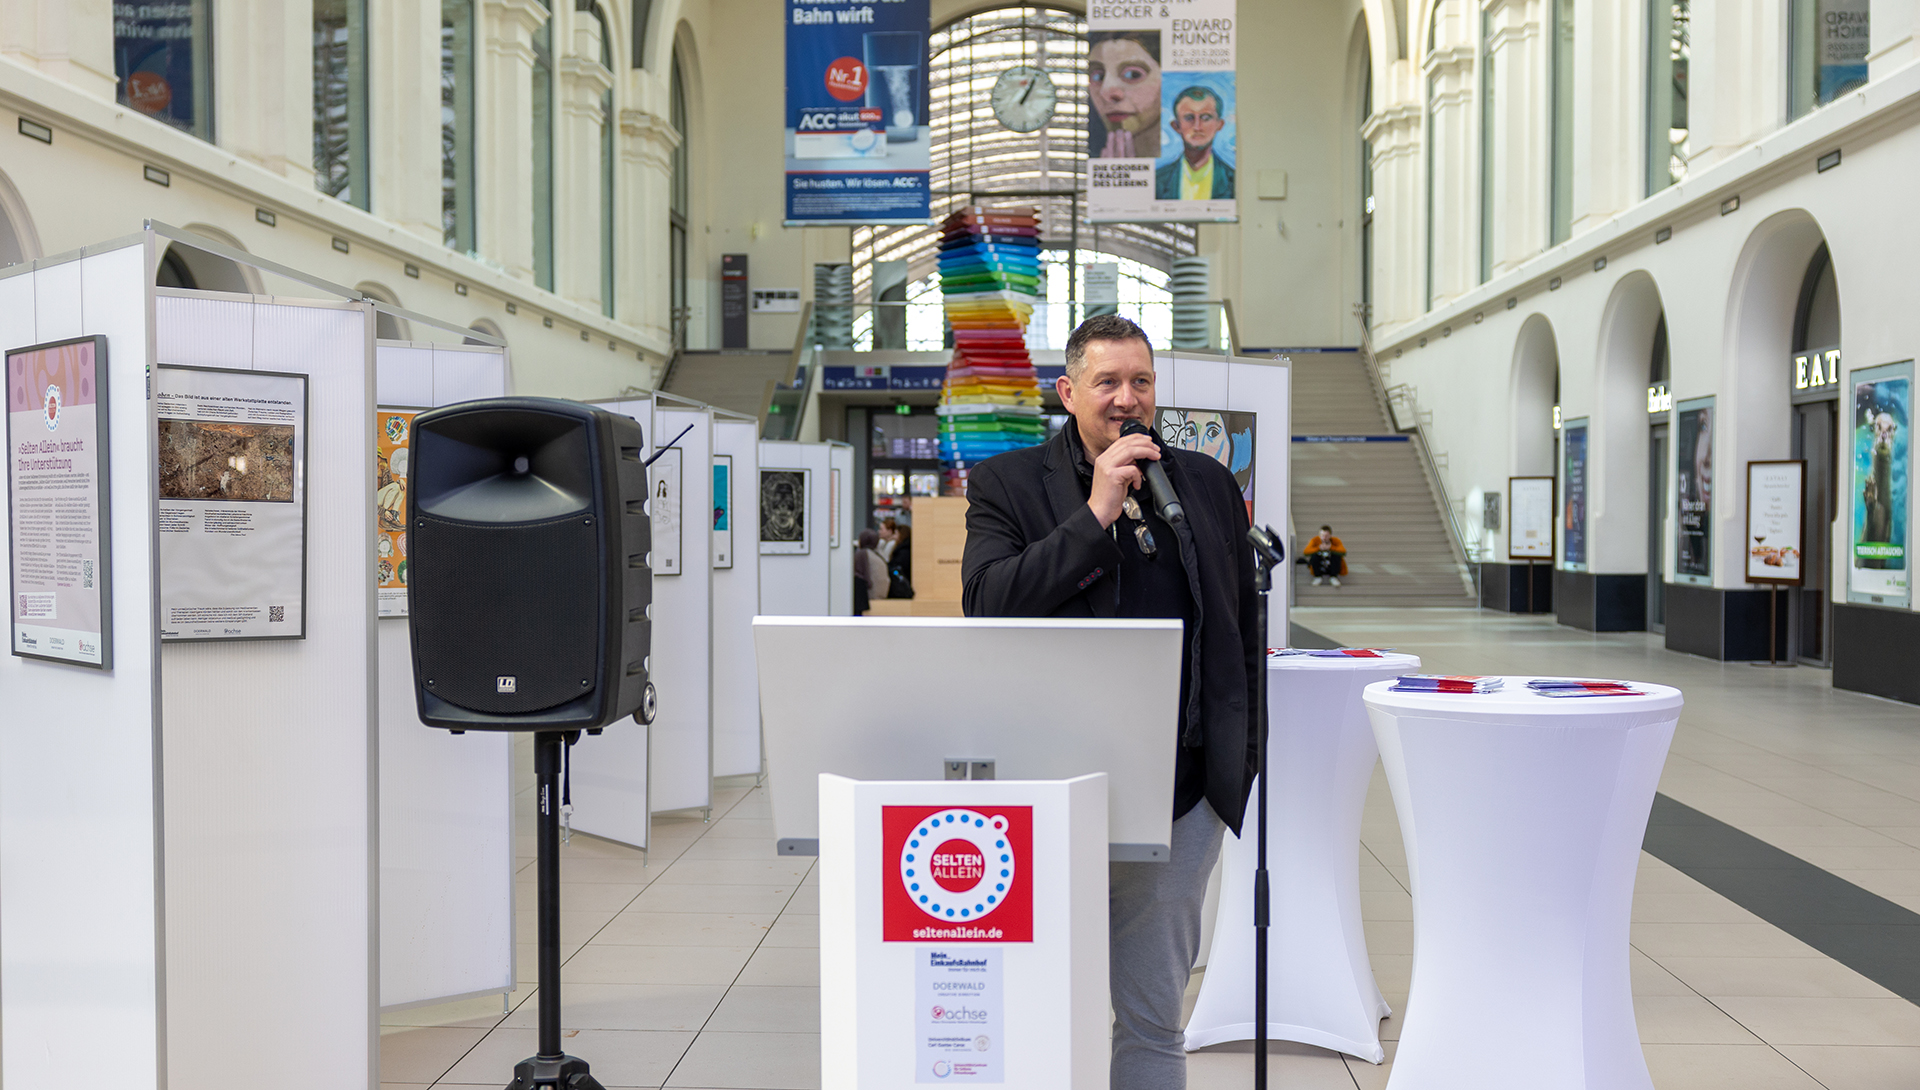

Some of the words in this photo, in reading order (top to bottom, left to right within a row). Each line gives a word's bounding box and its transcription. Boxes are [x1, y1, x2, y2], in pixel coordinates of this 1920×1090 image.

[793, 8, 833, 24] Bahn
[836, 6, 874, 23] wirft
[1092, 6, 1153, 18] BECKER
[1159, 6, 1170, 18] &
[1172, 19, 1232, 31] EDVARD
[1172, 33, 1230, 45] MUNCH
[1172, 58, 1231, 66] ALBERTINUM
[799, 113, 836, 130] ACC
[1093, 164, 1108, 172] DIE
[1093, 171, 1131, 179] FRAGEN
[793, 178, 808, 189] Sie
[1113, 179, 1149, 187] LEBENS
[1795, 350, 1840, 389] EAT
[60, 437, 84, 452] braucht
[18, 459, 30, 471] Ihre
[30, 457, 72, 472] Unterstützung
[932, 854, 982, 866] SELTEN
[933, 867, 982, 878] ALLEIN
[912, 926, 1003, 939] seltenallein.de
[933, 982, 986, 990] DOERWALD
[945, 1005, 988, 1020] achse
